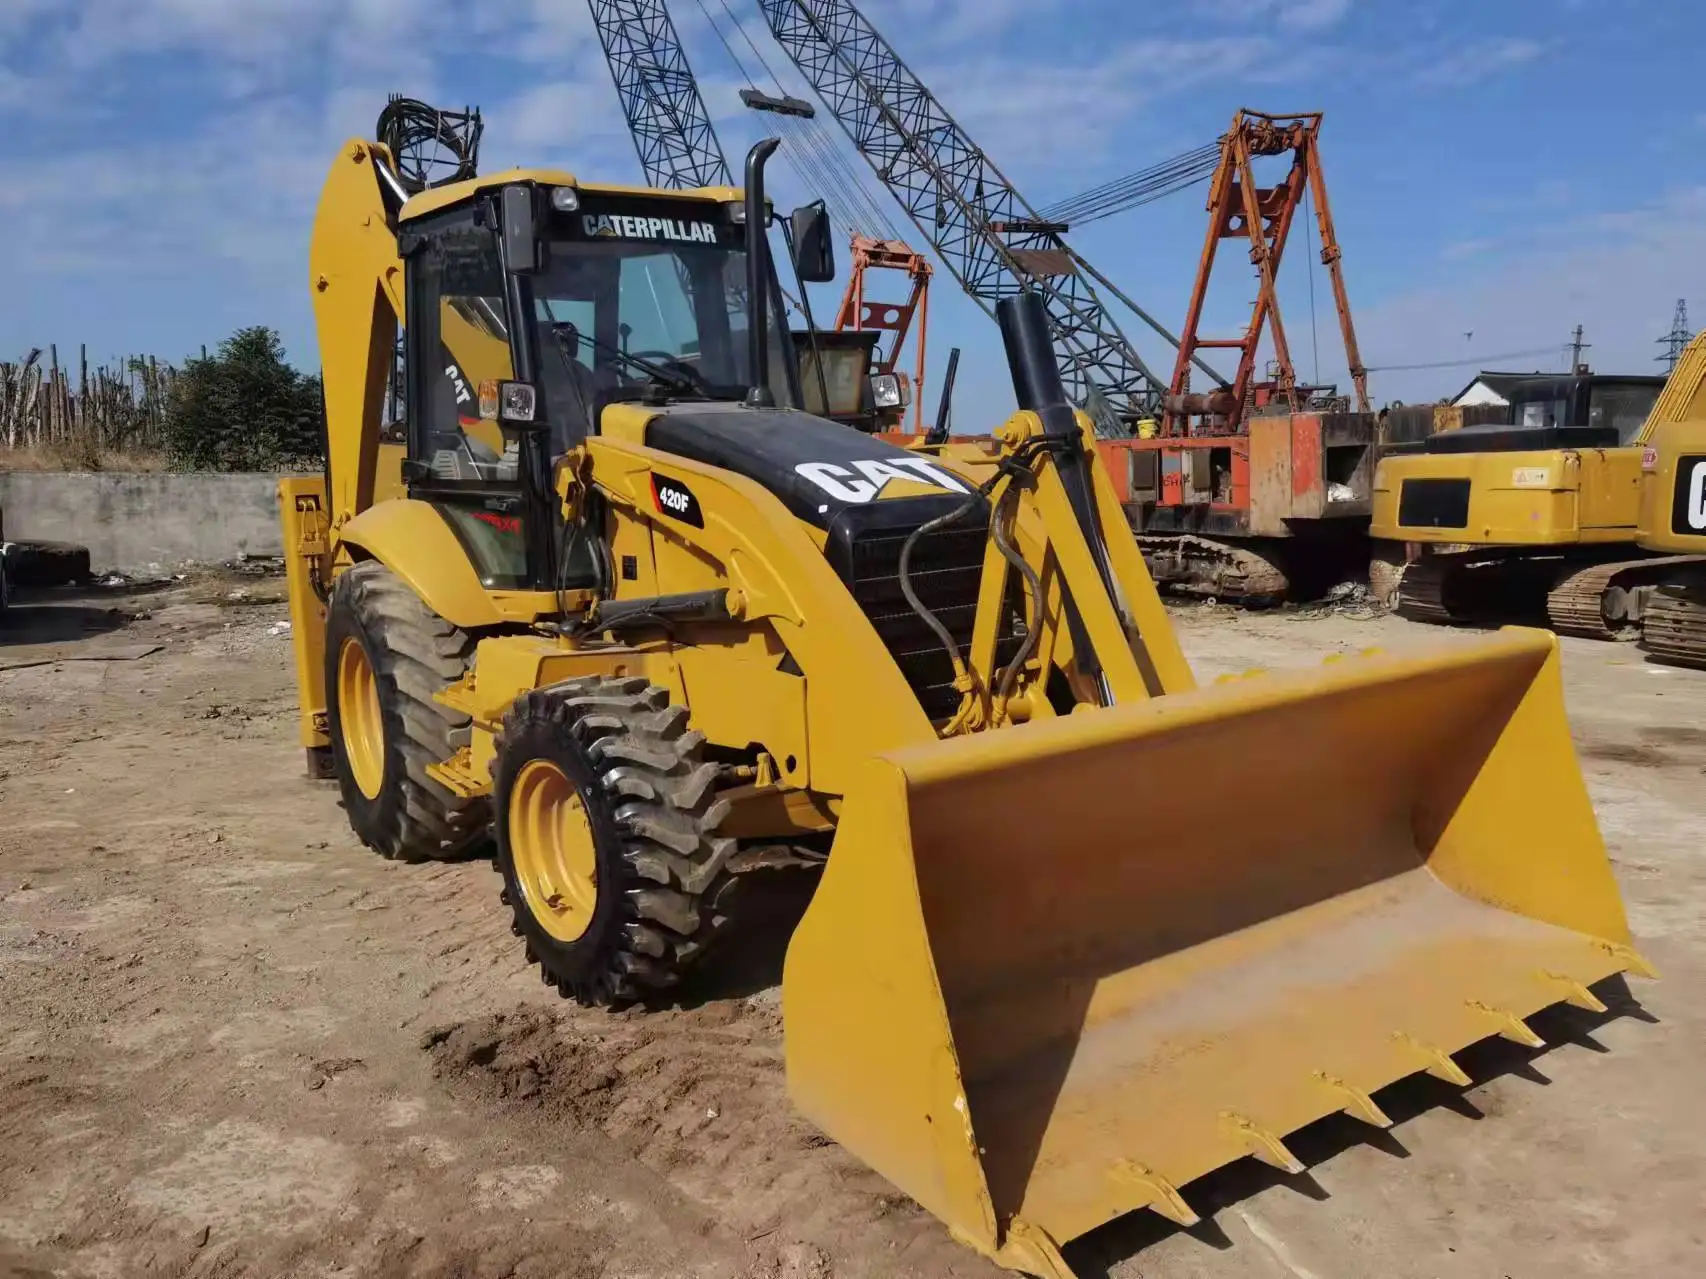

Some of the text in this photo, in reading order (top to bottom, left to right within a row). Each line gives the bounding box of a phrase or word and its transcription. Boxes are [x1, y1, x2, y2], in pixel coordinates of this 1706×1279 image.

[582, 214, 717, 243] CATERPILLAR
[445, 365, 470, 404] CAT
[795, 457, 971, 503] CAT
[660, 486, 689, 512] 420F
